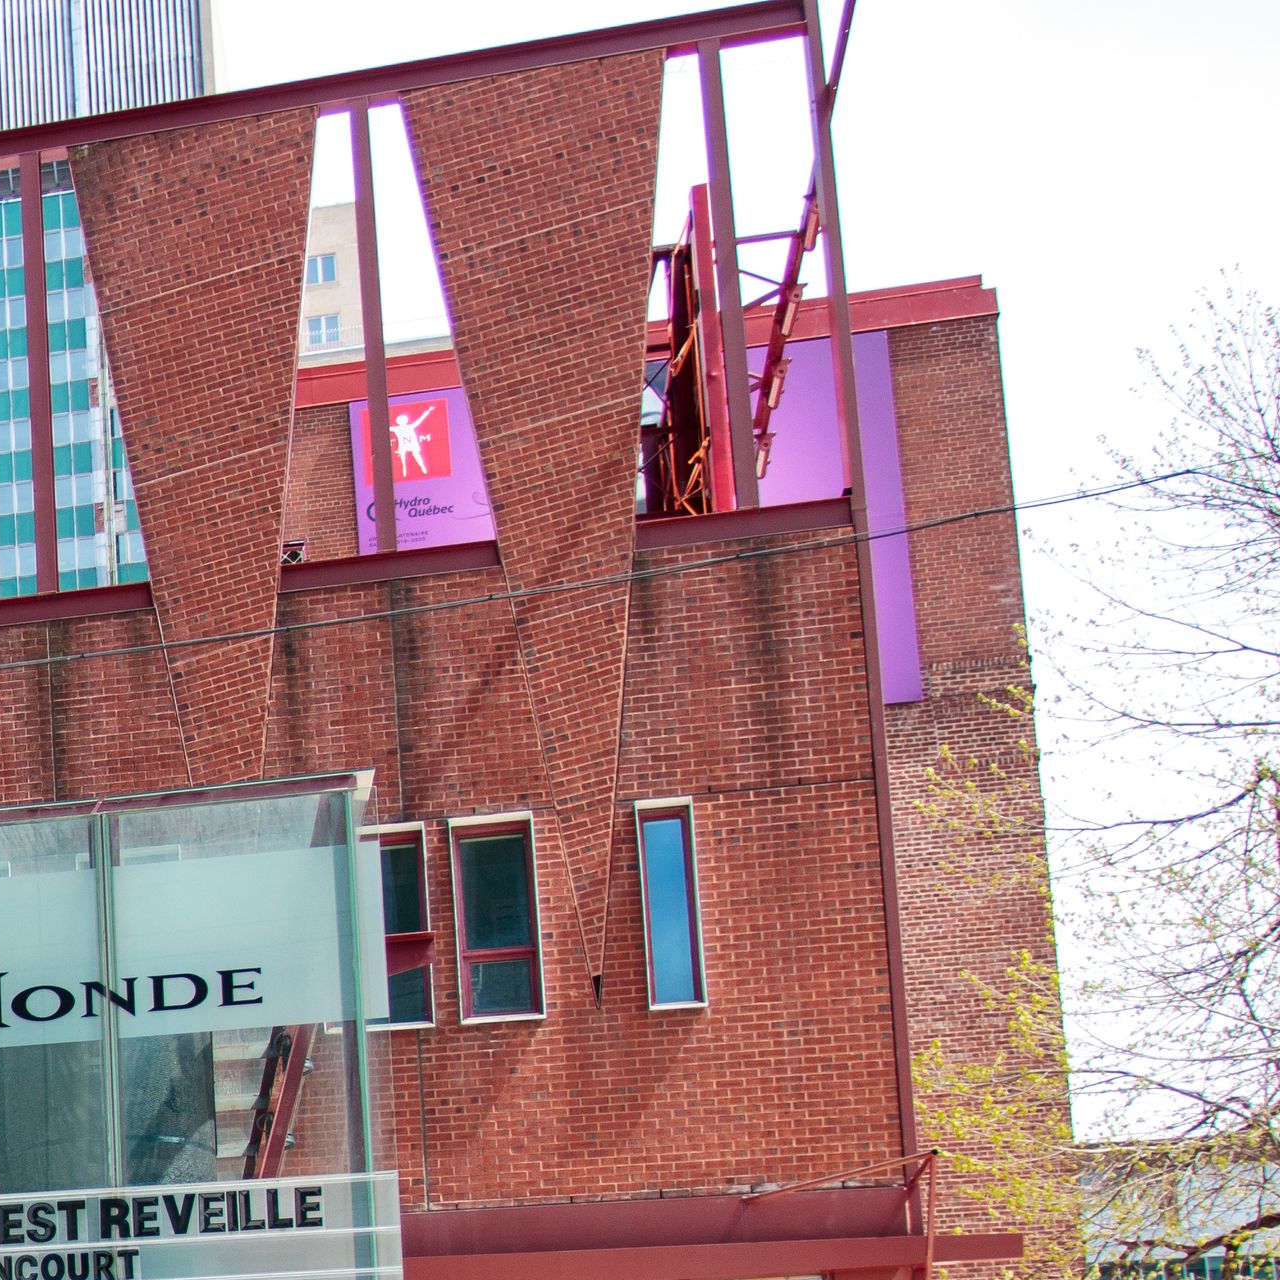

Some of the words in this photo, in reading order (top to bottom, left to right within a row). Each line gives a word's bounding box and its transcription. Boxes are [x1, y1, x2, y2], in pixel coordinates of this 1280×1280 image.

[394, 496, 431, 511] Hydro
[408, 504, 455, 518] Québec
[99, 1186, 323, 1239] REVEILLE
